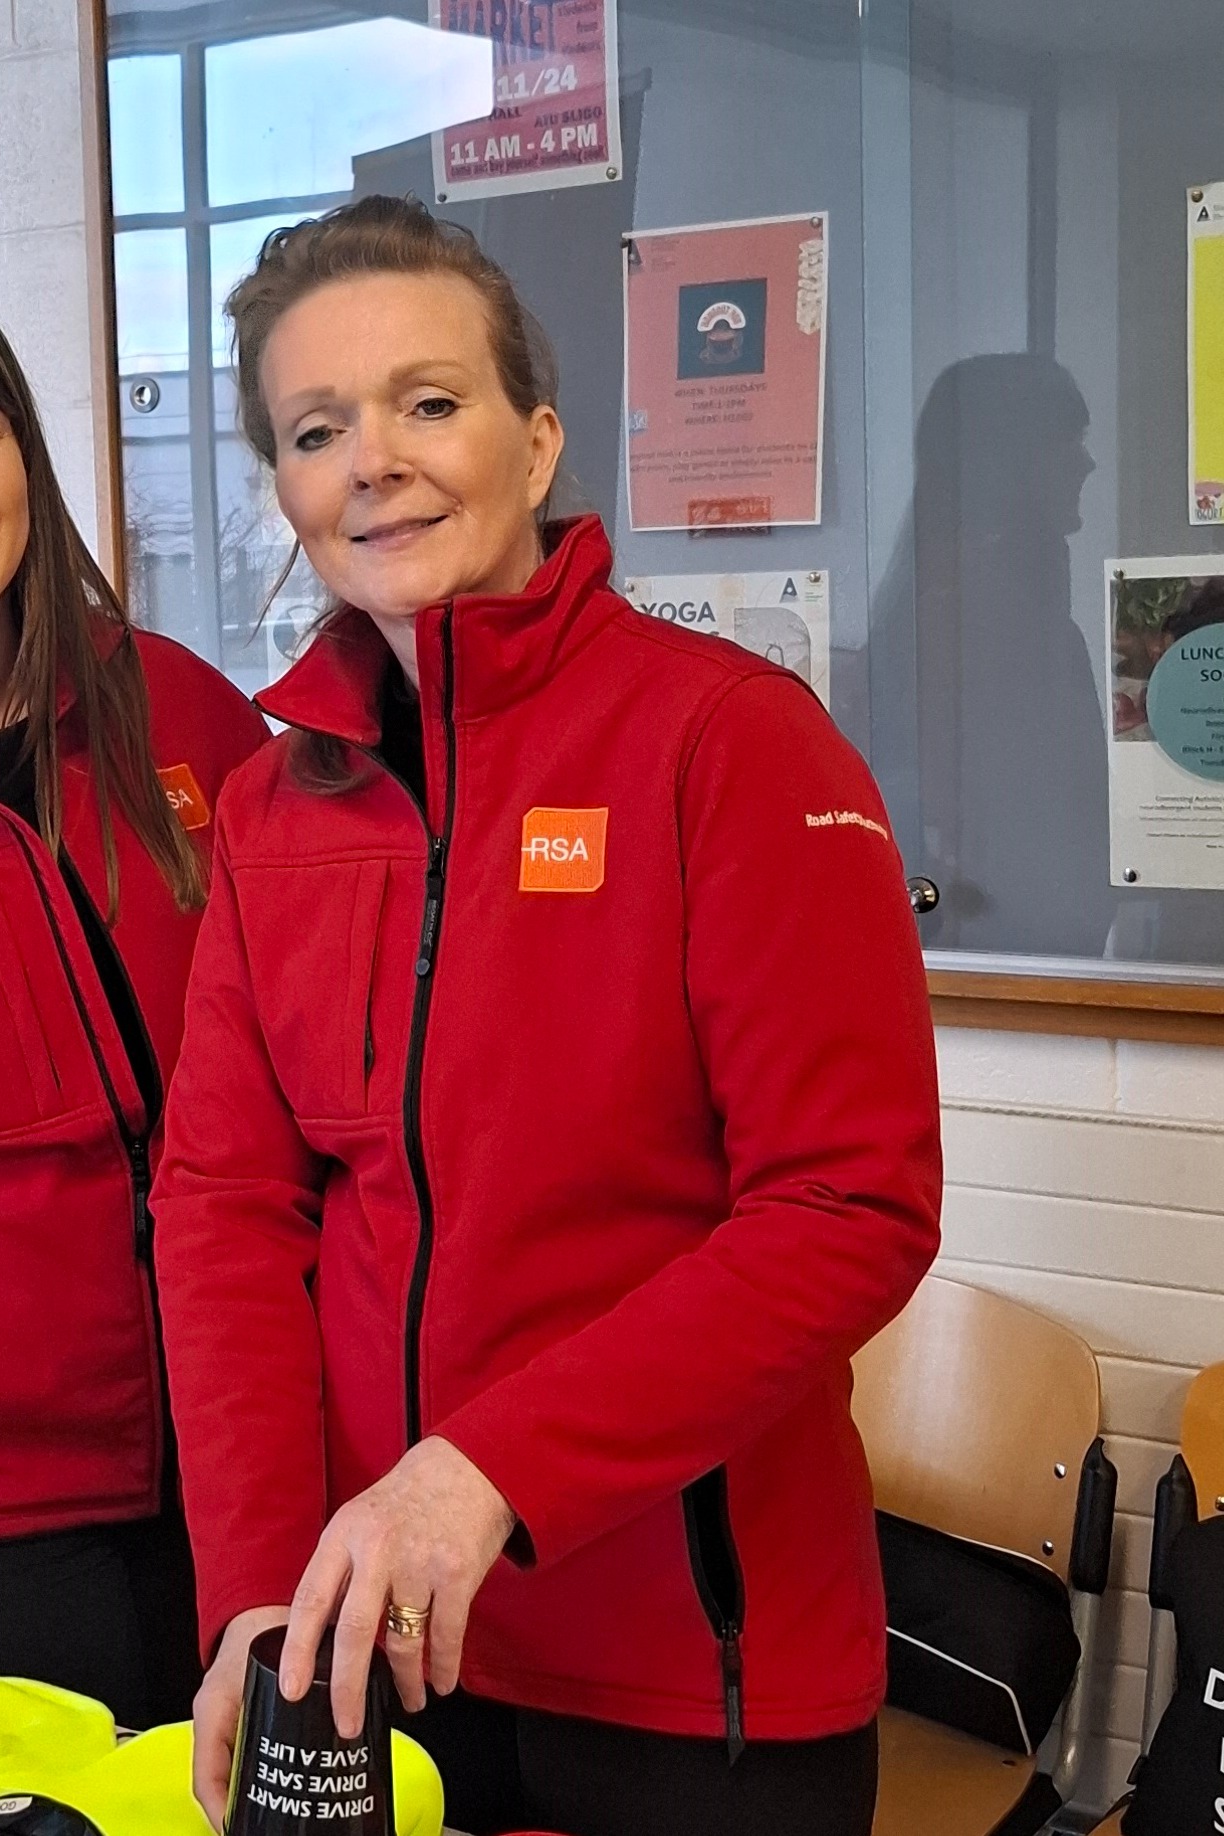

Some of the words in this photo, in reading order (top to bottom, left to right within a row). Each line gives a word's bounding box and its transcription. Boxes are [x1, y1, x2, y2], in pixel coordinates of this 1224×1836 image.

[496, 64, 578, 101] 11/24
[562, 106, 603, 123] SLIGO
[450, 141, 479, 166] 11
[484, 135, 521, 162] AM
[540, 130, 555, 152] 4
[561, 123, 598, 150] PM
[640, 601, 717, 623] YOGA
[805, 811, 834, 827] Road
[521, 837, 589, 862] RSA
[258, 1735, 295, 1763] LIFE
[300, 1748, 317, 1766] A
[320, 1746, 369, 1767] SAVE
[257, 1761, 304, 1790] SAFE
[307, 1772, 367, 1793] DRIVE
[246, 1783, 312, 1818] SMART
[316, 1795, 374, 1819] DRIVE
